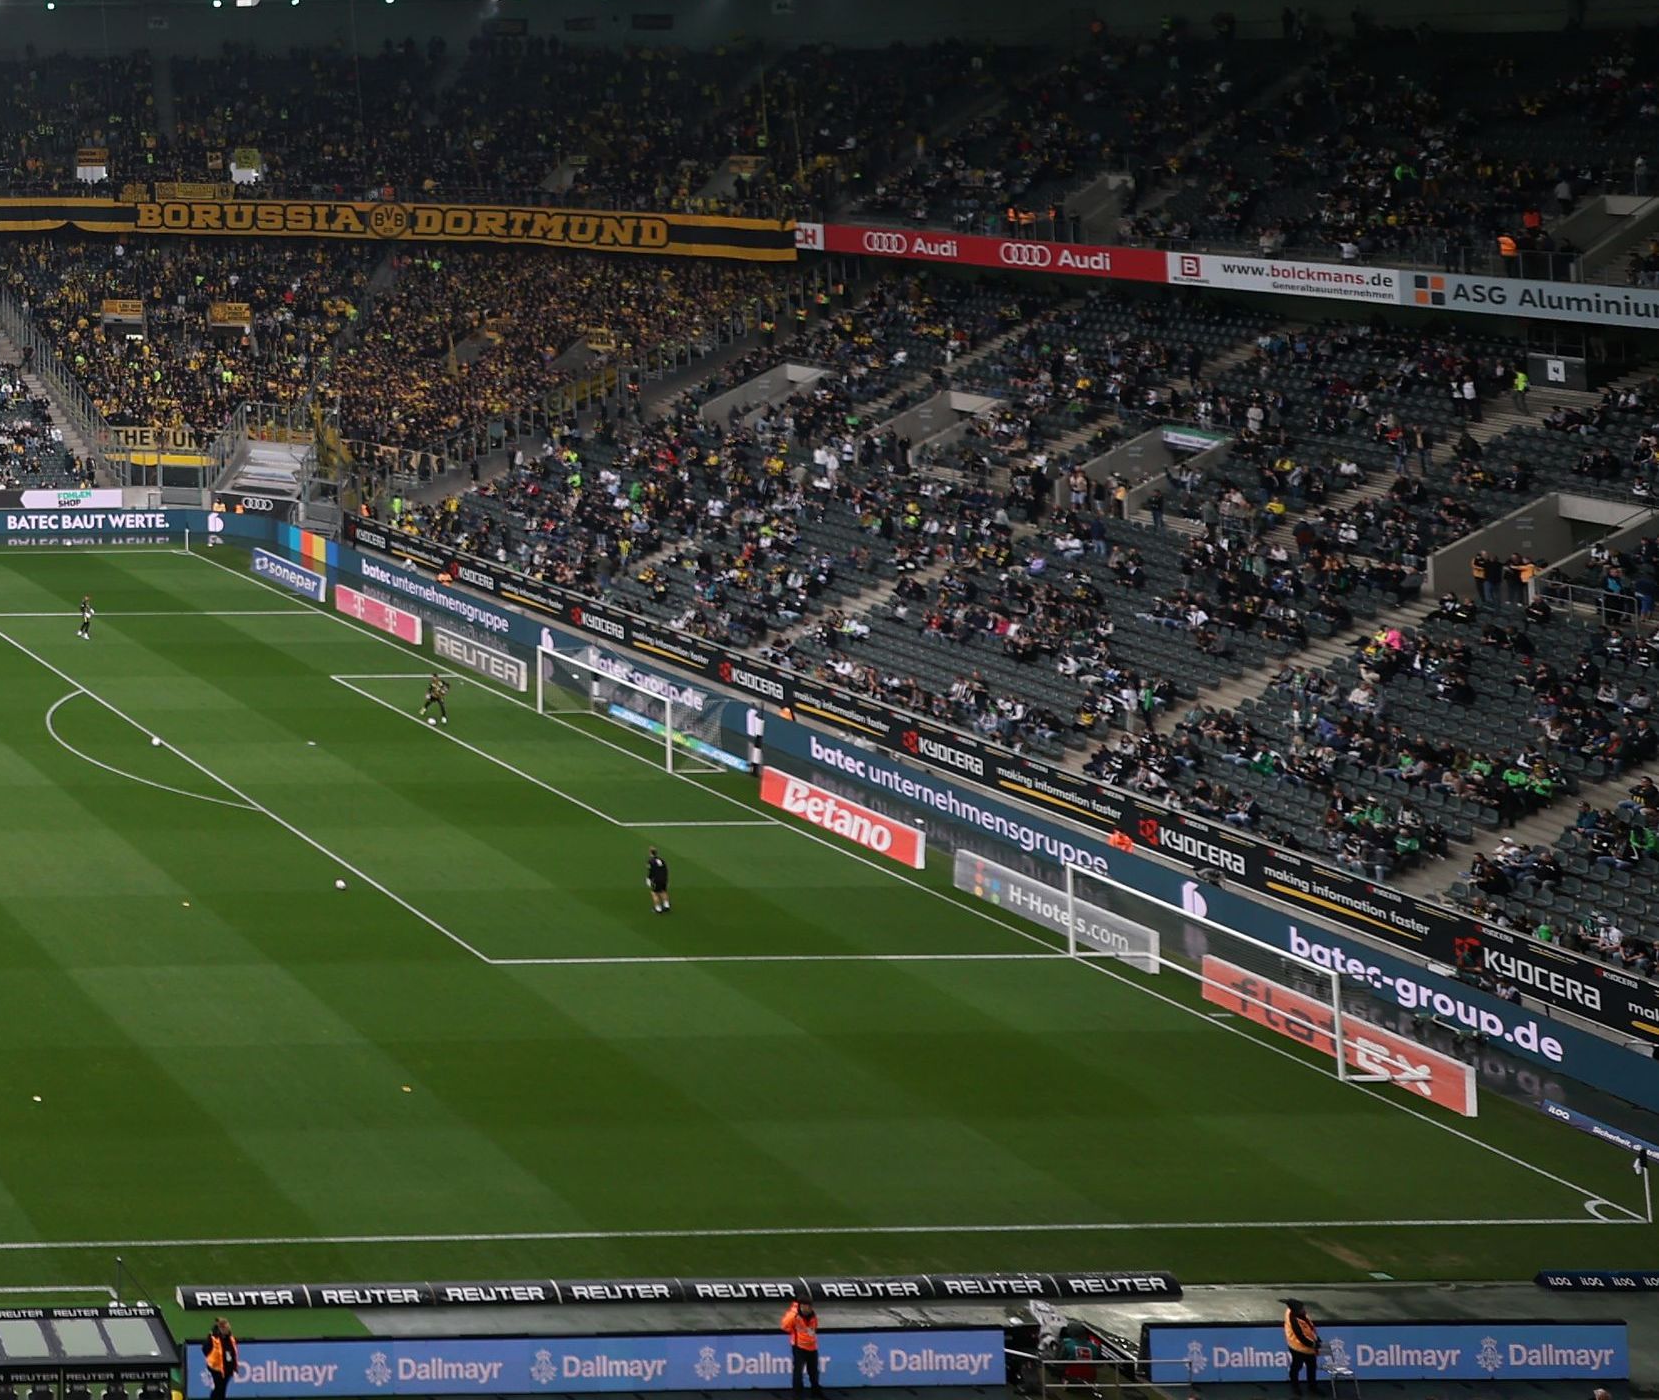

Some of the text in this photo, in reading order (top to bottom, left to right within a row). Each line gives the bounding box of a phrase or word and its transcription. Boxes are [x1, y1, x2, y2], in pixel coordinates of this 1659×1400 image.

[136, 203, 365, 232] BORUSSIA
[413, 207, 670, 249] DORTMUND
[911, 236, 958, 258] Audi
[1056, 239, 1111, 270] Audi
[1221, 262, 1394, 289] www.bolckmans.de
[1272, 281, 1395, 300] Generalbauunternehmen
[1454, 284, 1507, 305] ASG
[114, 429, 150, 446] THE
[268, 562, 318, 593] sonepar
[361, 559, 391, 584] batec
[392, 574, 509, 633] unternehmensgruppe
[582, 611, 625, 640] KYOCERA
[434, 631, 522, 688] REUTER
[732, 666, 785, 700] KYOCERA
[918, 735, 985, 777] KYOCERA
[809, 737, 1108, 876] batec unternehmensgruppe
[996, 766, 1122, 821] making information faster
[782, 779, 893, 853] Betano
[1159, 827, 1246, 875] KYOCERA
[1263, 863, 1430, 936] making information faster
[1008, 884, 1130, 953] H-Hotels.com
[1289, 926, 1564, 1062] batec-group.de
[1483, 946, 1601, 1011] KYOCERA
[1603, 969, 1639, 990] KYOCERA
[1592, 1125, 1632, 1149] Sicherheit,
[196, 1289, 294, 1307] REUTER
[695, 1282, 798, 1299] REUTER
[1068, 1277, 1168, 1294] REUTER
[902, 1350, 993, 1374] Dallmayr
[1508, 1343, 1614, 1368] Dallmayr
[234, 1359, 338, 1386] Dallmayr
